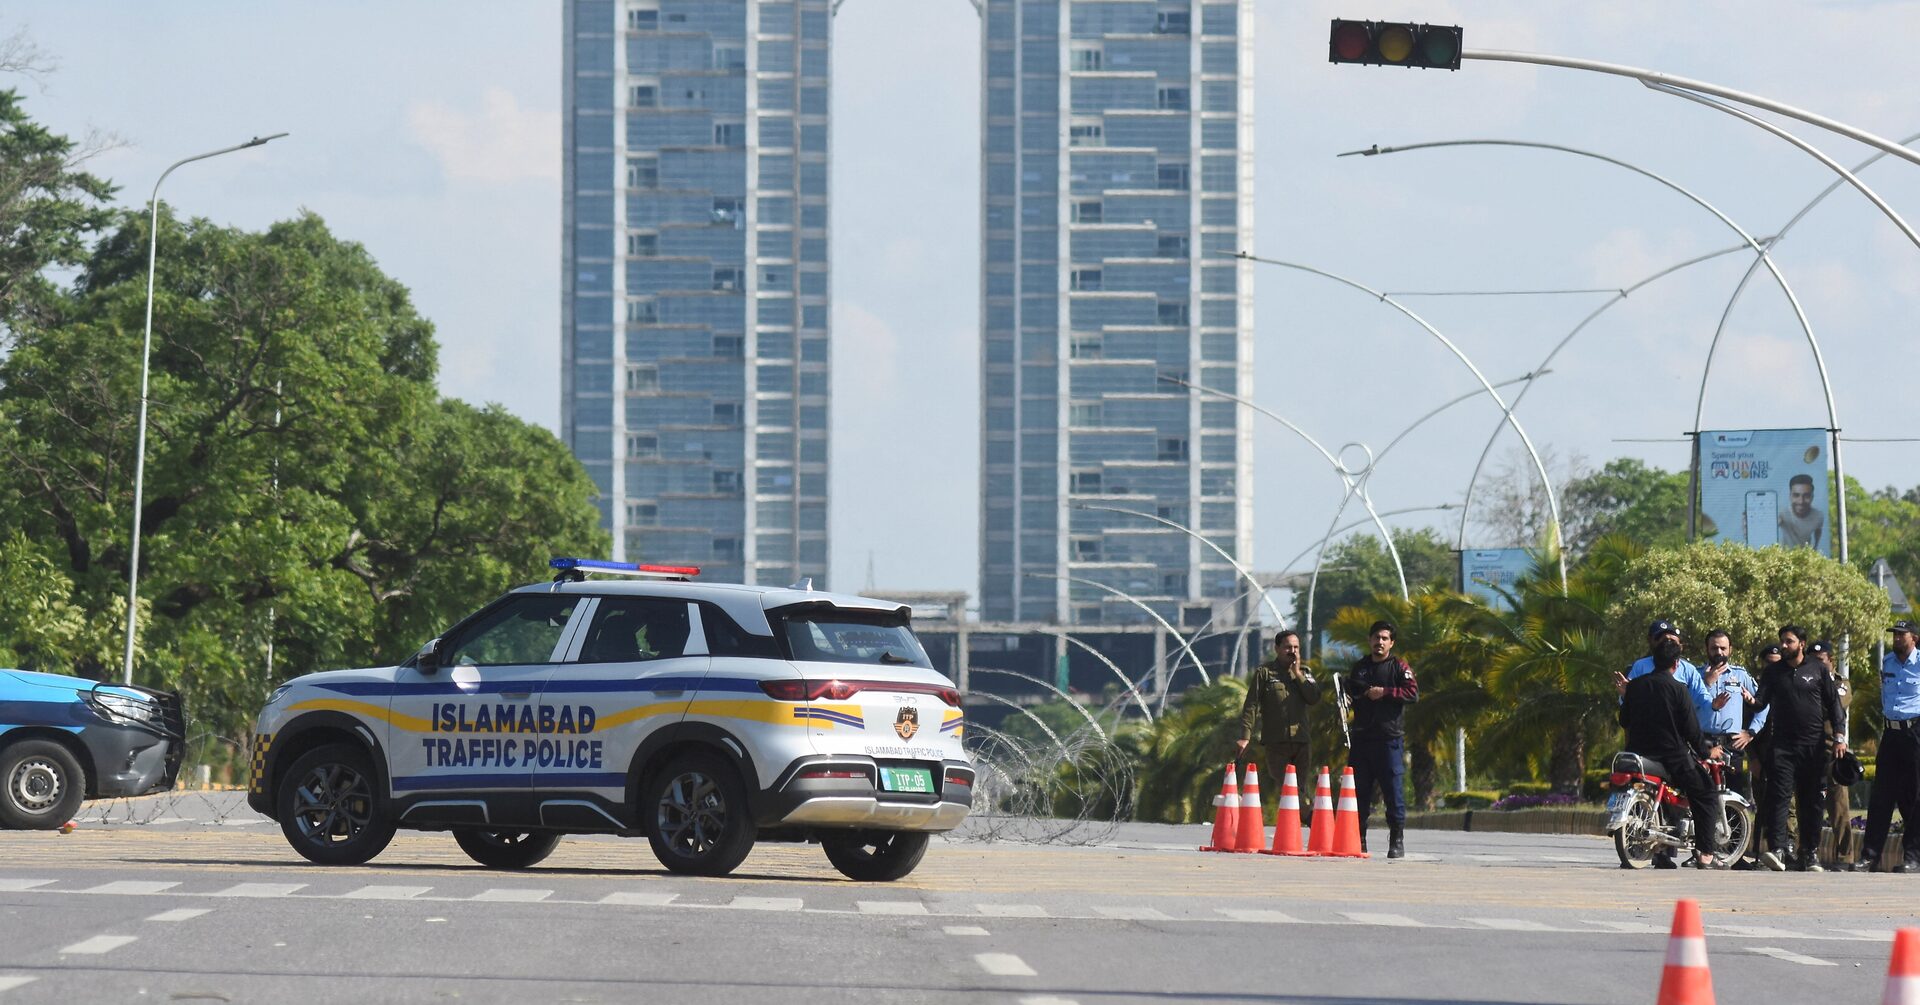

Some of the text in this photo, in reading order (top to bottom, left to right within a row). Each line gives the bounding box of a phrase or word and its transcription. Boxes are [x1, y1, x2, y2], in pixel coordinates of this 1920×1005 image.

[1711, 451, 1736, 460] Spend
[1733, 470, 1768, 479] COINS
[432, 703, 596, 734] ISLAMABAD
[422, 738, 603, 769] TRAFFIC POLICE
[864, 745, 903, 755] ISLAMABAD
[903, 747, 927, 757] TRAFFIC
